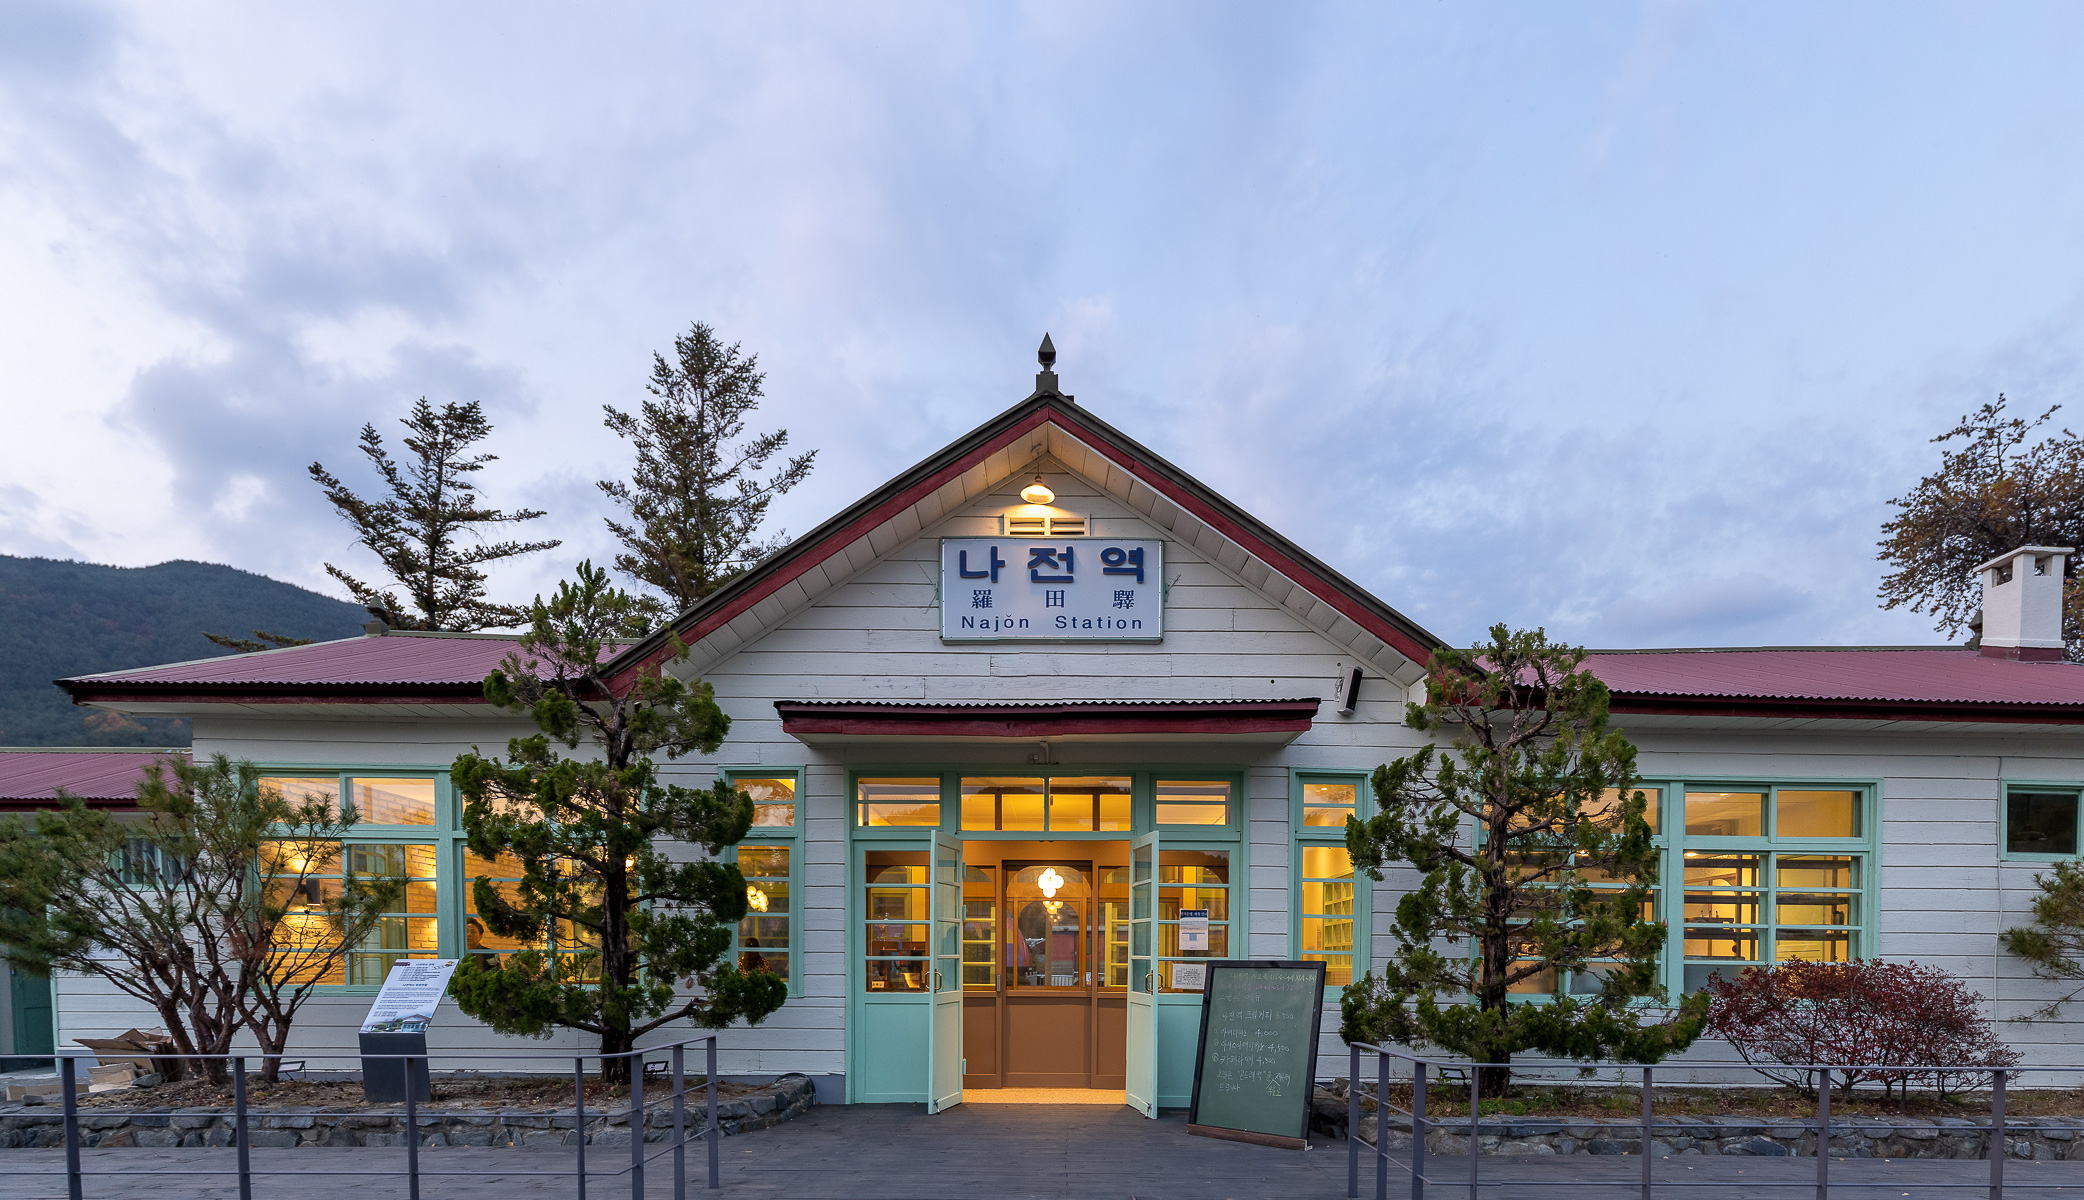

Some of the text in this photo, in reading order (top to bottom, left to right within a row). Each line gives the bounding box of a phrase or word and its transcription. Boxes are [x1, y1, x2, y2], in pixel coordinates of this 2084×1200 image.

[958, 545, 1145, 584] 나전역
[970, 589, 1136, 610] 羅田驛
[961, 613, 1143, 632] Najŏn Station
[1244, 993, 1262, 1003] 메뉴
[1222, 1009, 1243, 1021] 나전역
[1267, 1042, 1290, 1054] 4,500
[1216, 1069, 1233, 1080] 오늘은
